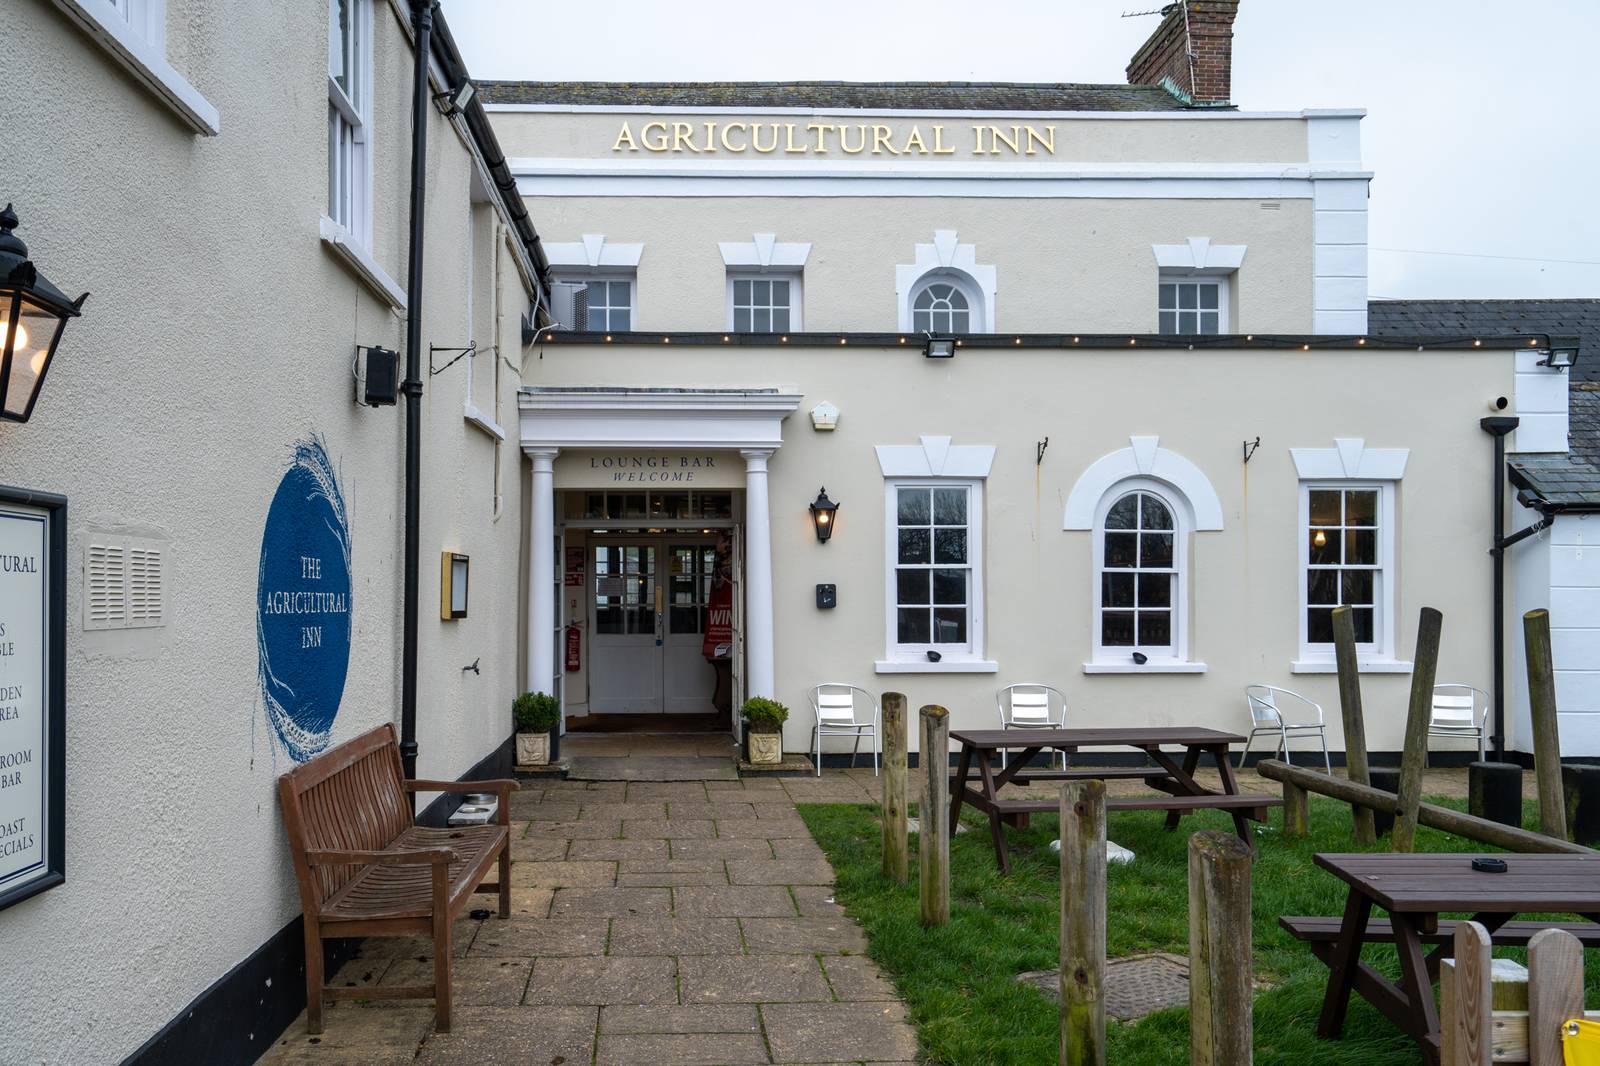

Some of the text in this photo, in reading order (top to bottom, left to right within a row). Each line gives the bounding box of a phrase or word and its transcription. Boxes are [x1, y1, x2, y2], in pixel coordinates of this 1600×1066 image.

[612, 120, 1057, 156] AGRICULTURAL INN
[591, 456, 715, 468] LOUNGE BAR
[613, 471, 694, 482] WELCOME
[0, 555, 37, 573] URAL
[301, 555, 322, 579] THE
[265, 591, 348, 614] AGRICULTURAL
[301, 626, 322, 649] INN
[0, 685, 22, 701] DEN
[0, 749, 32, 769] ROOM
[1, 772, 22, 789] BAR
